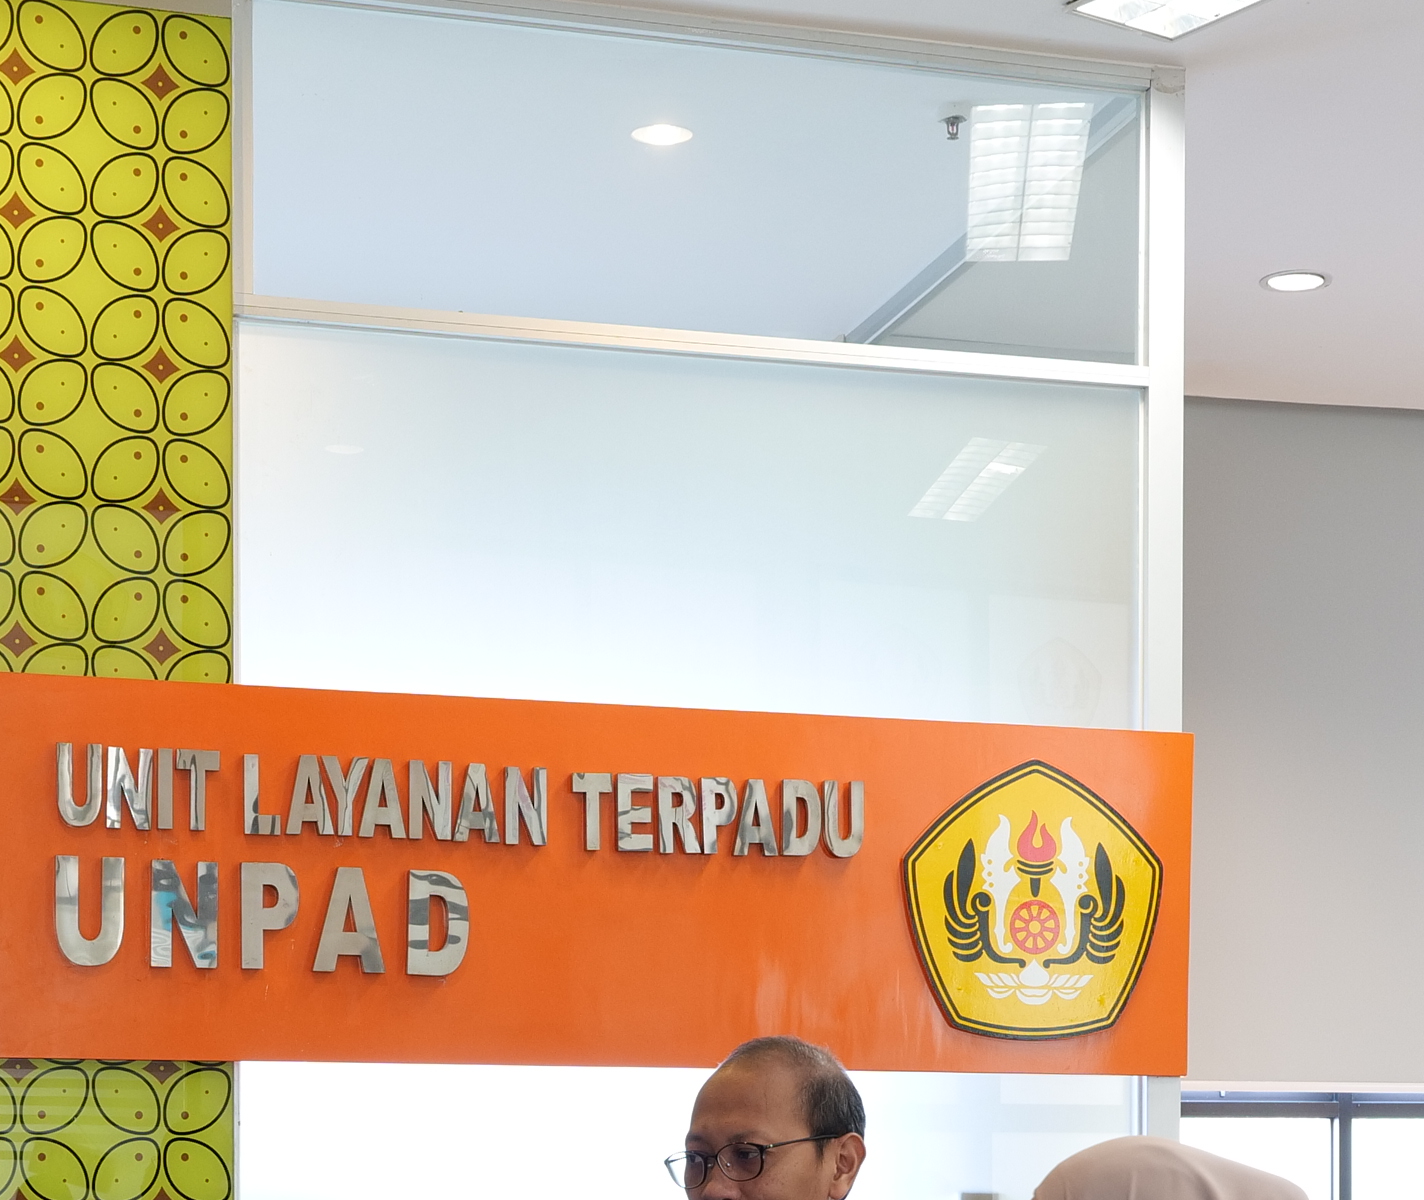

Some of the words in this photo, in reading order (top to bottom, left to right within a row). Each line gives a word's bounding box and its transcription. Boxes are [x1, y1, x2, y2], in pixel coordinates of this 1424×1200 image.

[55, 742, 221, 831] UNIT
[242, 753, 547, 846] LAYANAN
[572, 772, 865, 858] TERPADU
[55, 854, 470, 977] UNPAD
